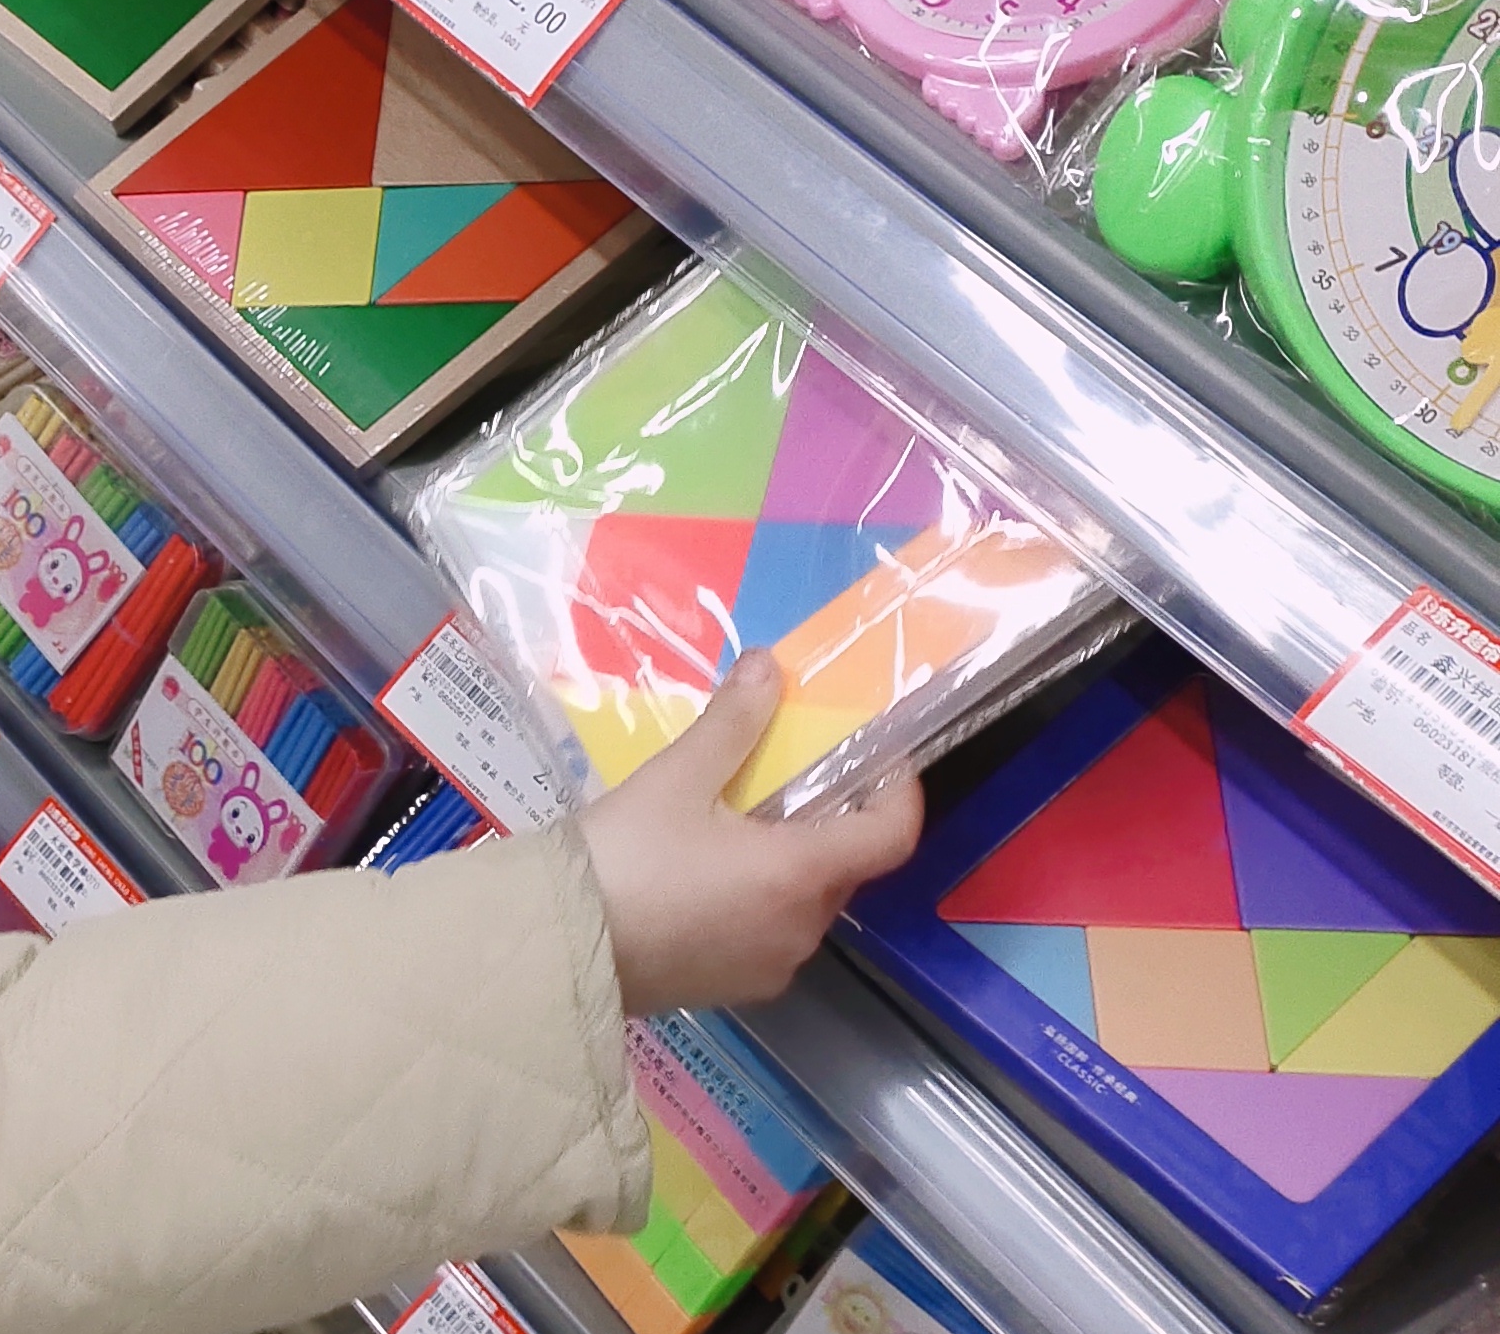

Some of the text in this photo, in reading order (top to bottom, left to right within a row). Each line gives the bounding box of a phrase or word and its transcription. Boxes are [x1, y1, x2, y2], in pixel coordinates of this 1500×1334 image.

[497, 29, 522, 52] 1001
[1427, 222, 1463, 255] 19
[1374, 246, 1408, 272] 7
[1312, 270, 1336, 290] 35
[1390, 380, 1407, 395] 31
[1414, 403, 1437, 424] 30
[1398, 617, 1434, 648] 品名
[1427, 602, 1500, 668] 东升超市
[1410, 713, 1479, 770] 06023181
[172, 728, 230, 788] 100
[1053, 1050, 1107, 1095] CLASSIC
